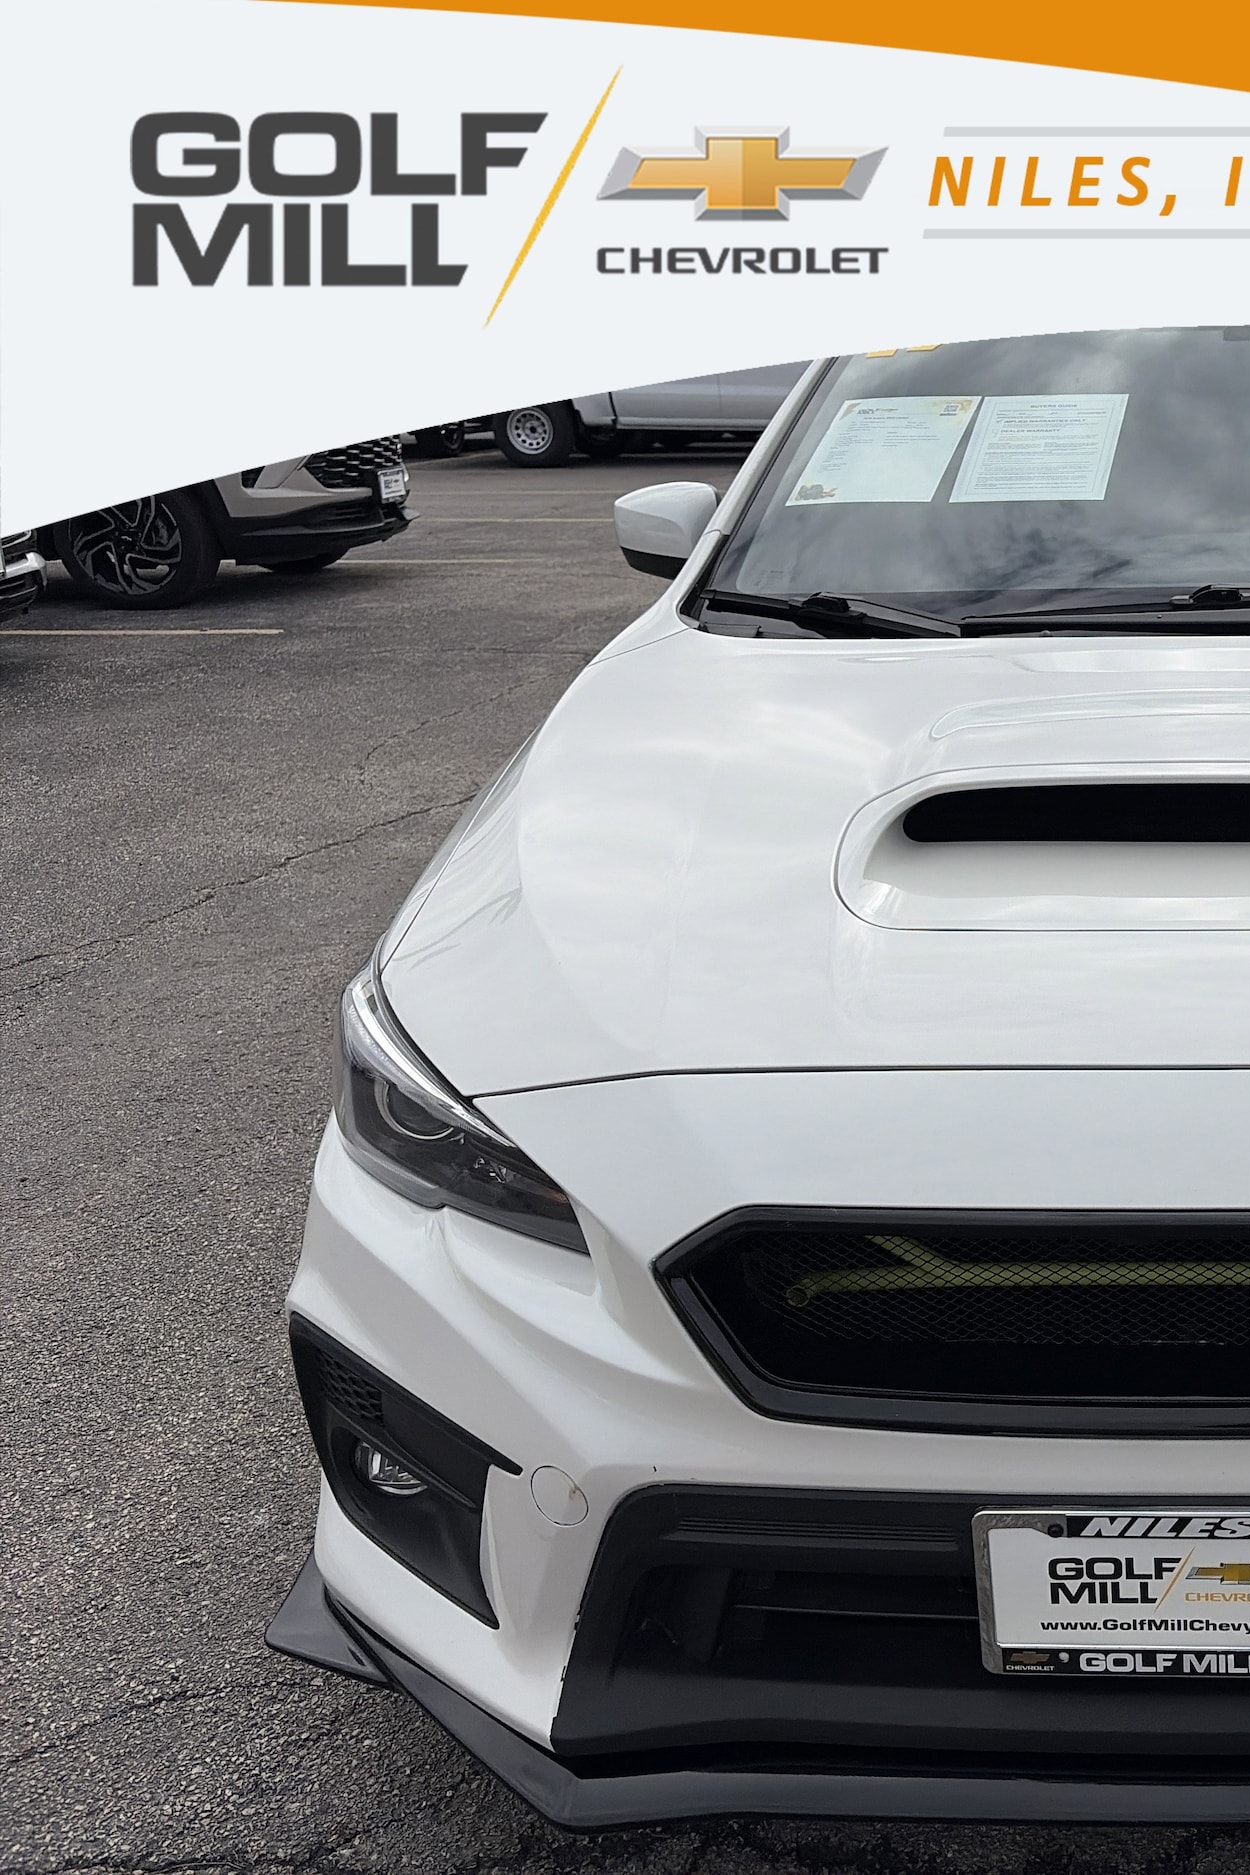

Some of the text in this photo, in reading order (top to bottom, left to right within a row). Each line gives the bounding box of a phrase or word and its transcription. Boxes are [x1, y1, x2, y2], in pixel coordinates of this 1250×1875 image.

[1048, 1557, 1182, 1581] GOLF
[1050, 1581, 1158, 1605] MILL
[1006, 1664, 1055, 1672] CHEVROLET
[1079, 1652, 1177, 1673] GOLF
